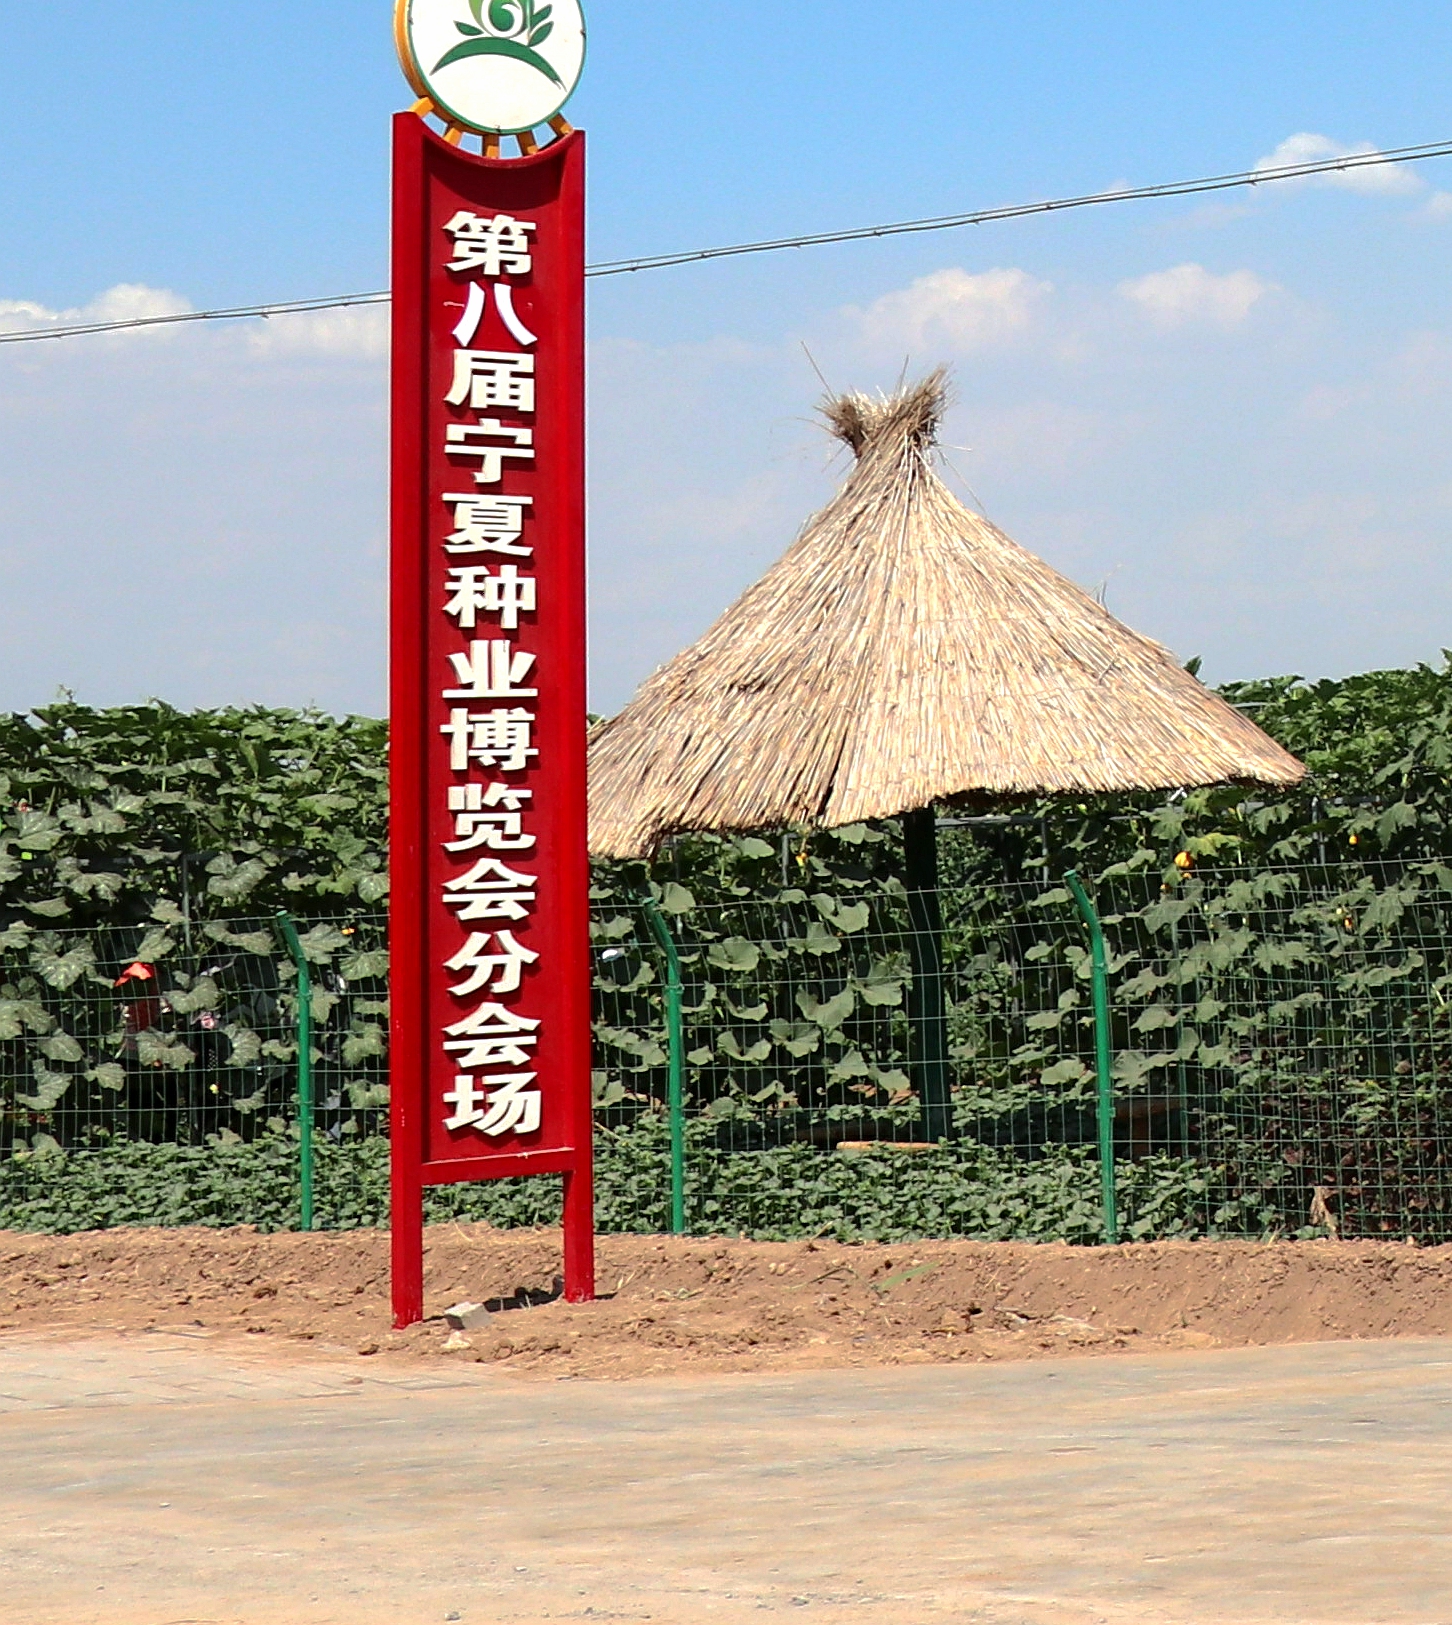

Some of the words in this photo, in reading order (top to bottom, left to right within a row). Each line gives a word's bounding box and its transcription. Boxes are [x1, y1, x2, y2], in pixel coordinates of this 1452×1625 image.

[441, 210, 541, 1136] 第八届宁夏种业博览会分会场
